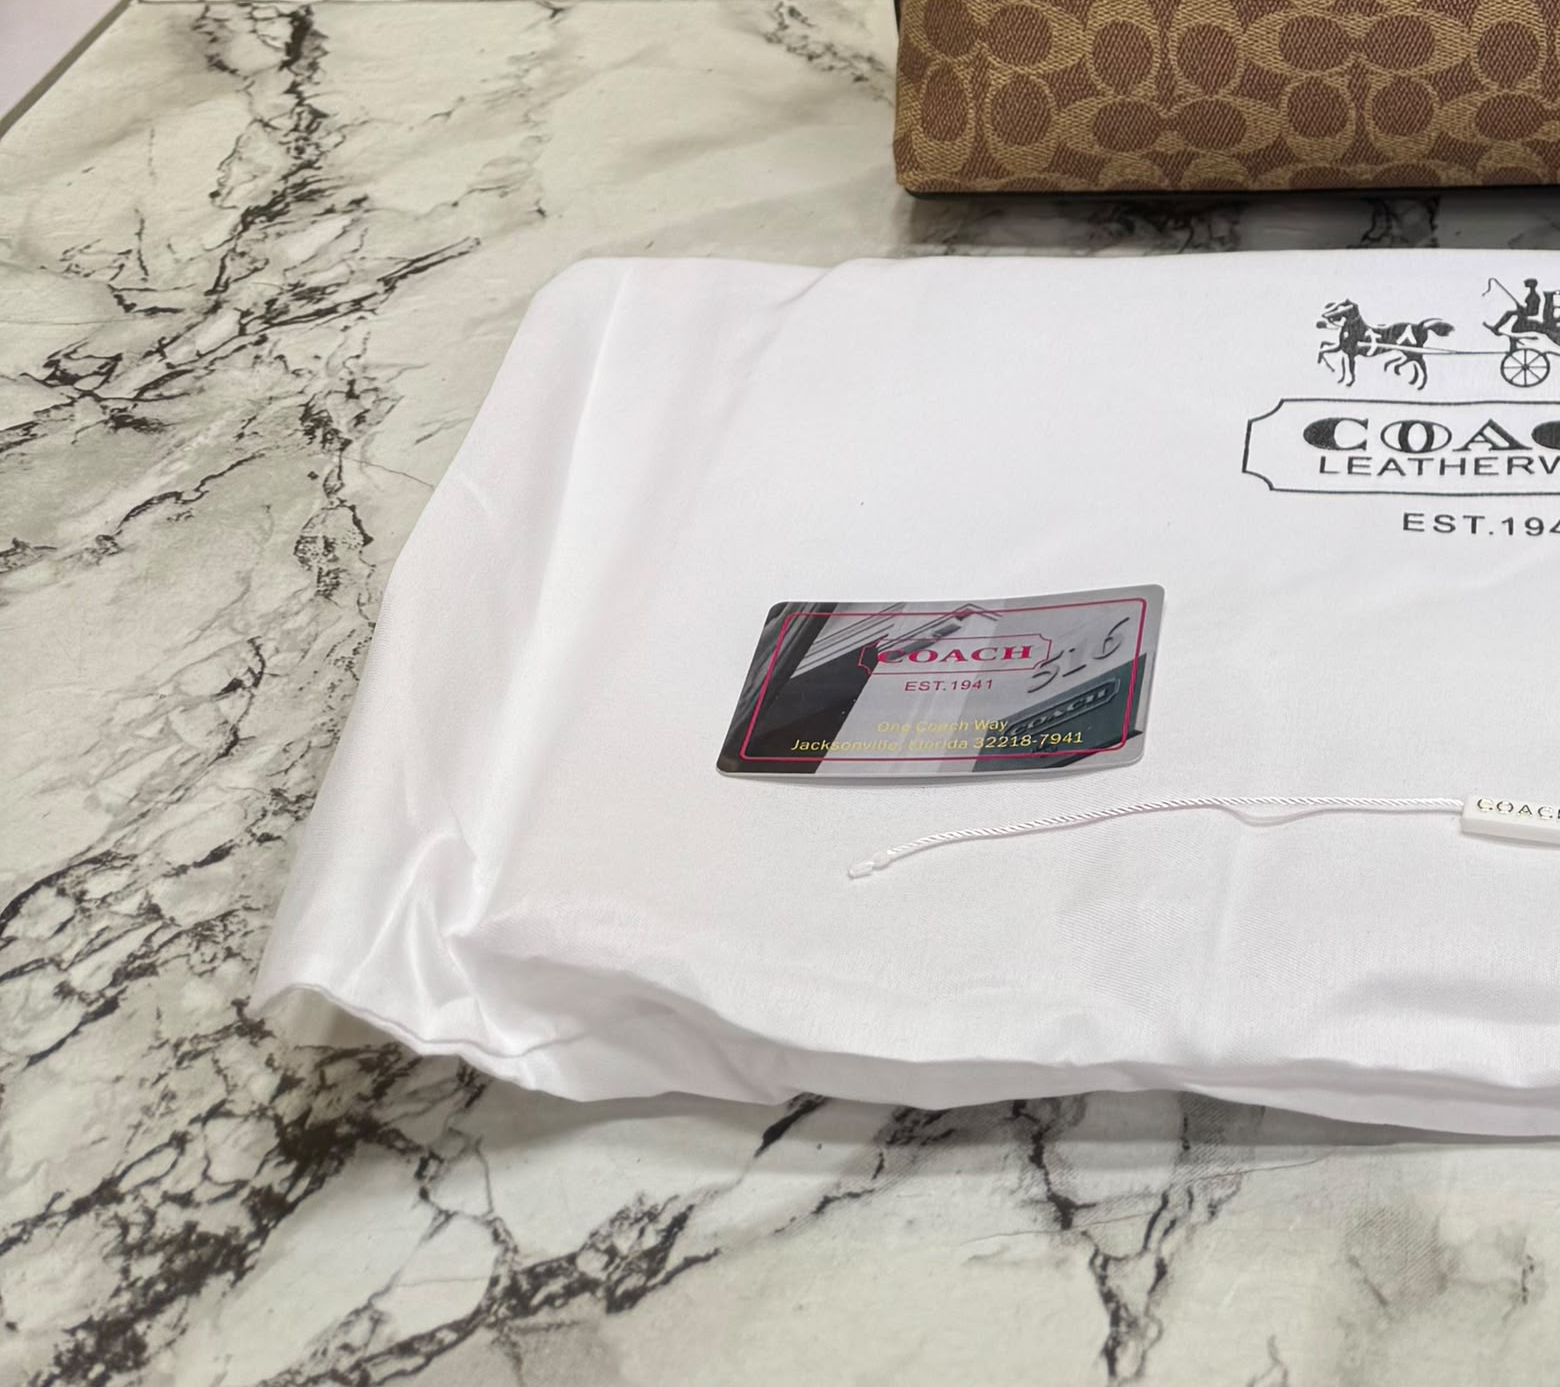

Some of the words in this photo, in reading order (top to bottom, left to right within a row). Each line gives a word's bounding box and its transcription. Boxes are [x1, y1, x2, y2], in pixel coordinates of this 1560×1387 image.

[877, 645, 1033, 664] COACH
[904, 679, 993, 692] EST.1941
[877, 720, 910, 732] One
[974, 719, 1008, 732] Way
[973, 731, 1084, 749] 32218-7941
